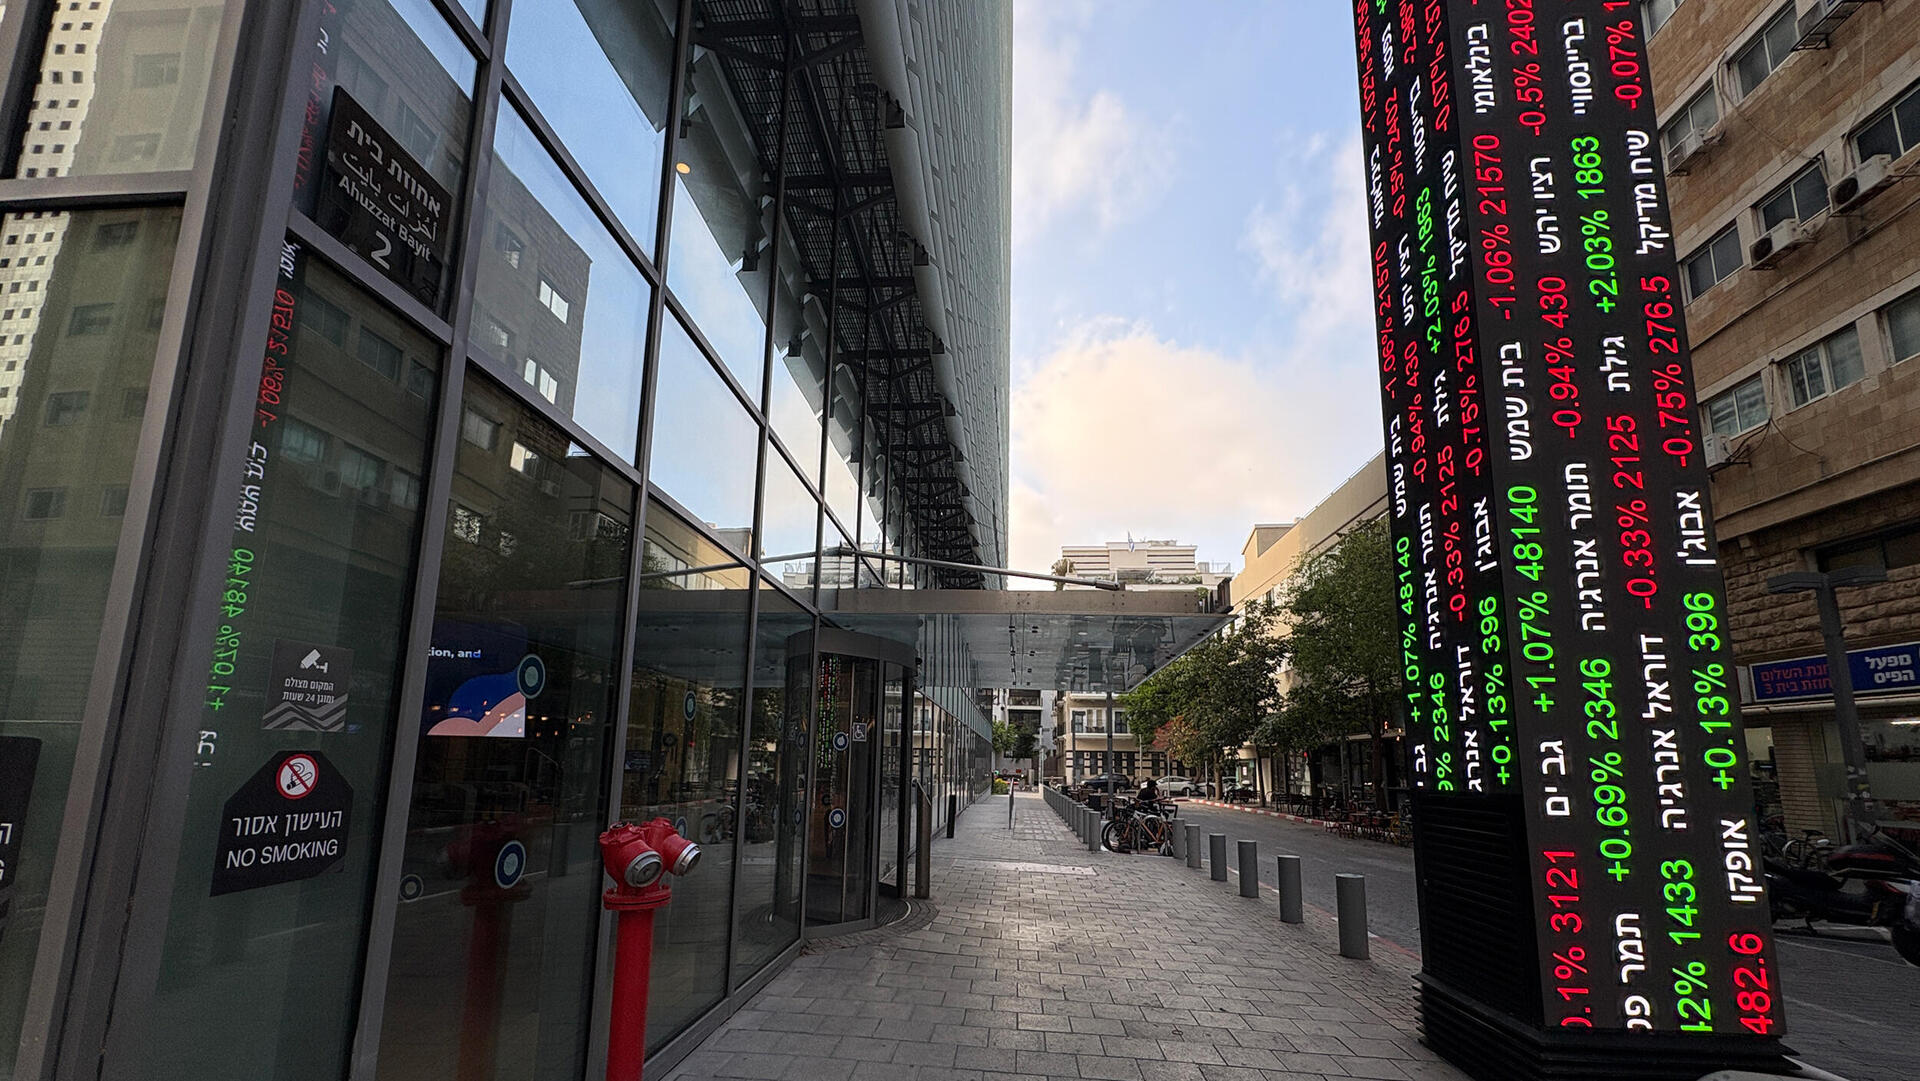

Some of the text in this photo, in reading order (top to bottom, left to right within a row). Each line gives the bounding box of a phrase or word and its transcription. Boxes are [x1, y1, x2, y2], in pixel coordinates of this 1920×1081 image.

[1429, 41, 1450, 132] -0.07%
[1464, 23, 1495, 113] בינלאומי
[1512, 63, 1546, 136] -0.5%
[1562, 18, 1593, 114] בריינסוויי
[1605, 20, 1643, 109] -0.07%
[1384, 87, 1400, 153] 2402
[1409, 75, 1426, 175] בריינסוויי
[1626, 130, 1653, 174] שיח
[347, 120, 441, 218] אחוזת בית
[1370, 143, 1384, 229] בינלאומי
[1389, 150, 1405, 218] -0.5%
[1441, 149, 1457, 199] שיח
[1472, 134, 1507, 215] 21570
[1530, 157, 1555, 198] רציו
[1571, 136, 1605, 199] 1863
[338, 175, 431, 262] Ahuzzat Bayit
[371, 230, 392, 270] 2
[1416, 187, 1433, 253] 1863
[1446, 198, 1467, 280] מדיקל
[1535, 208, 1561, 254] יהש
[1633, 183, 1669, 254] מדיקל
[1375, 241, 1391, 316] 21570
[1481, 224, 1516, 320] -1.06%
[1579, 210, 1618, 313] +2.03%
[1401, 283, 1414, 326] יהש
[1420, 254, 1442, 354] +2.03%
[1451, 290, 1474, 372] 276.5
[1537, 276, 1569, 328] 430
[1640, 276, 1679, 354] 276.5
[1380, 316, 1397, 399] -1.06%
[1403, 340, 1419, 387] 430
[1499, 341, 1525, 387] בית
[1543, 337, 1582, 438] -0.94%
[1599, 335, 1630, 392] גילת
[1432, 369, 1449, 427] גילת
[1458, 374, 1483, 476] -0.75%
[1505, 396, 1532, 460] שמש
[1652, 363, 1693, 467] -0.75%
[1390, 414, 1402, 458] בית
[1407, 393, 1427, 483] -0.94%
[1606, 415, 1643, 489] 2125
[1393, 463, 1407, 518] שמש
[1437, 445, 1457, 516] 2125
[1564, 463, 1592, 530] תומר
[1419, 502, 1433, 564] תומר
[1507, 485, 1544, 581] 48140
[1615, 499, 1657, 609] -0.33%
[1396, 536, 1414, 615] 48140
[1424, 568, 1441, 650] אנרגיה
[1443, 521, 1466, 622] -0.33%
[1573, 539, 1605, 630] אנרגיה
[457, 649, 481, 659] and
[1478, 596, 1501, 654] 396
[1517, 591, 1556, 712] +1.07%
[1683, 592, 1720, 651] 396
[282, 692, 304, 701] שעות
[284, 677, 334, 692] המקום מצולם
[305, 693, 315, 702] 24
[1402, 622, 1421, 722] +1.07%
[1456, 645, 1475, 721] דוראל
[1579, 658, 1618, 740] 2346
[1640, 634, 1672, 718] דוראל
[1761, 667, 1803, 682] השלום
[1776, 681, 1799, 694] בית
[1864, 654, 1912, 670] מפעל
[1429, 672, 1449, 742] 2346
[1484, 663, 1511, 784] +0.13%
[1692, 663, 1737, 789] +0.13%
[1539, 740, 1566, 775] גב
[1651, 729, 1687, 829] אנרגיה
[232, 810, 342, 837] העישון אסור
[1589, 751, 1632, 881] +0.69%
[226, 839, 338, 869] NO SMOKING
[1720, 819, 1763, 902] אופקו
[1543, 851, 1582, 933] 3121
[1660, 859, 1701, 945] 1433
[1615, 913, 1645, 983] תמר
[1728, 933, 1773, 1034] 482.6
